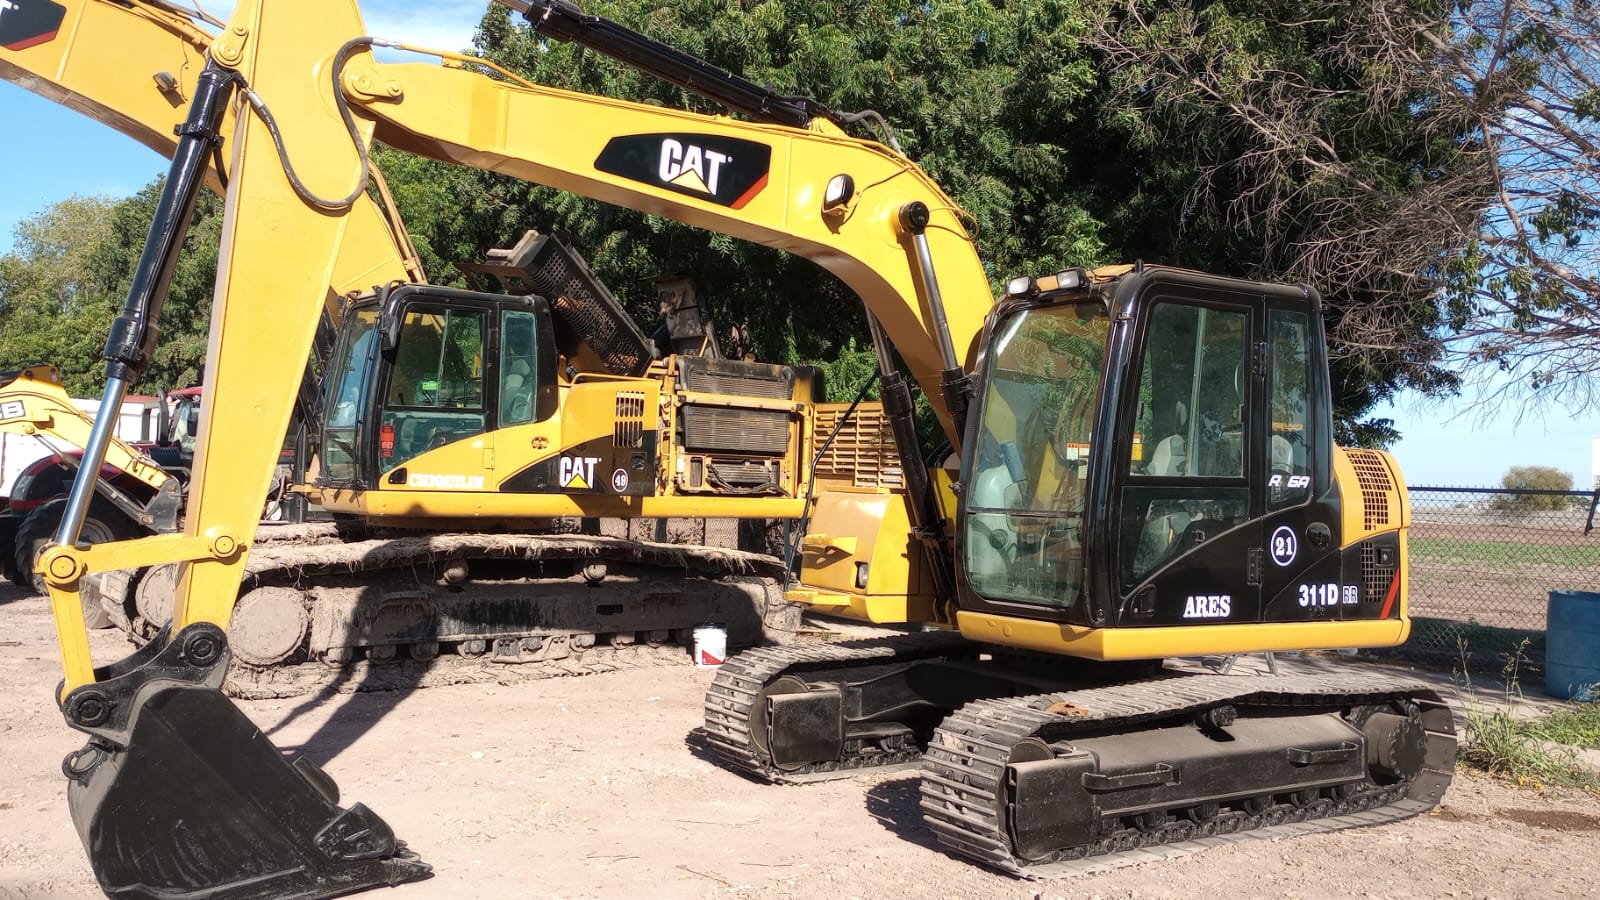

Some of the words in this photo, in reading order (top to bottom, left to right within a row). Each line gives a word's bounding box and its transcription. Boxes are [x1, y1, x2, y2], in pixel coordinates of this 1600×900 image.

[659, 138, 726, 195] CAT
[560, 456, 597, 489] CAT
[614, 474, 625, 487] 49
[1275, 536, 1293, 556] 21
[1299, 584, 1338, 606] 311D
[1342, 585, 1357, 604] RR
[1183, 595, 1231, 618] ARES
